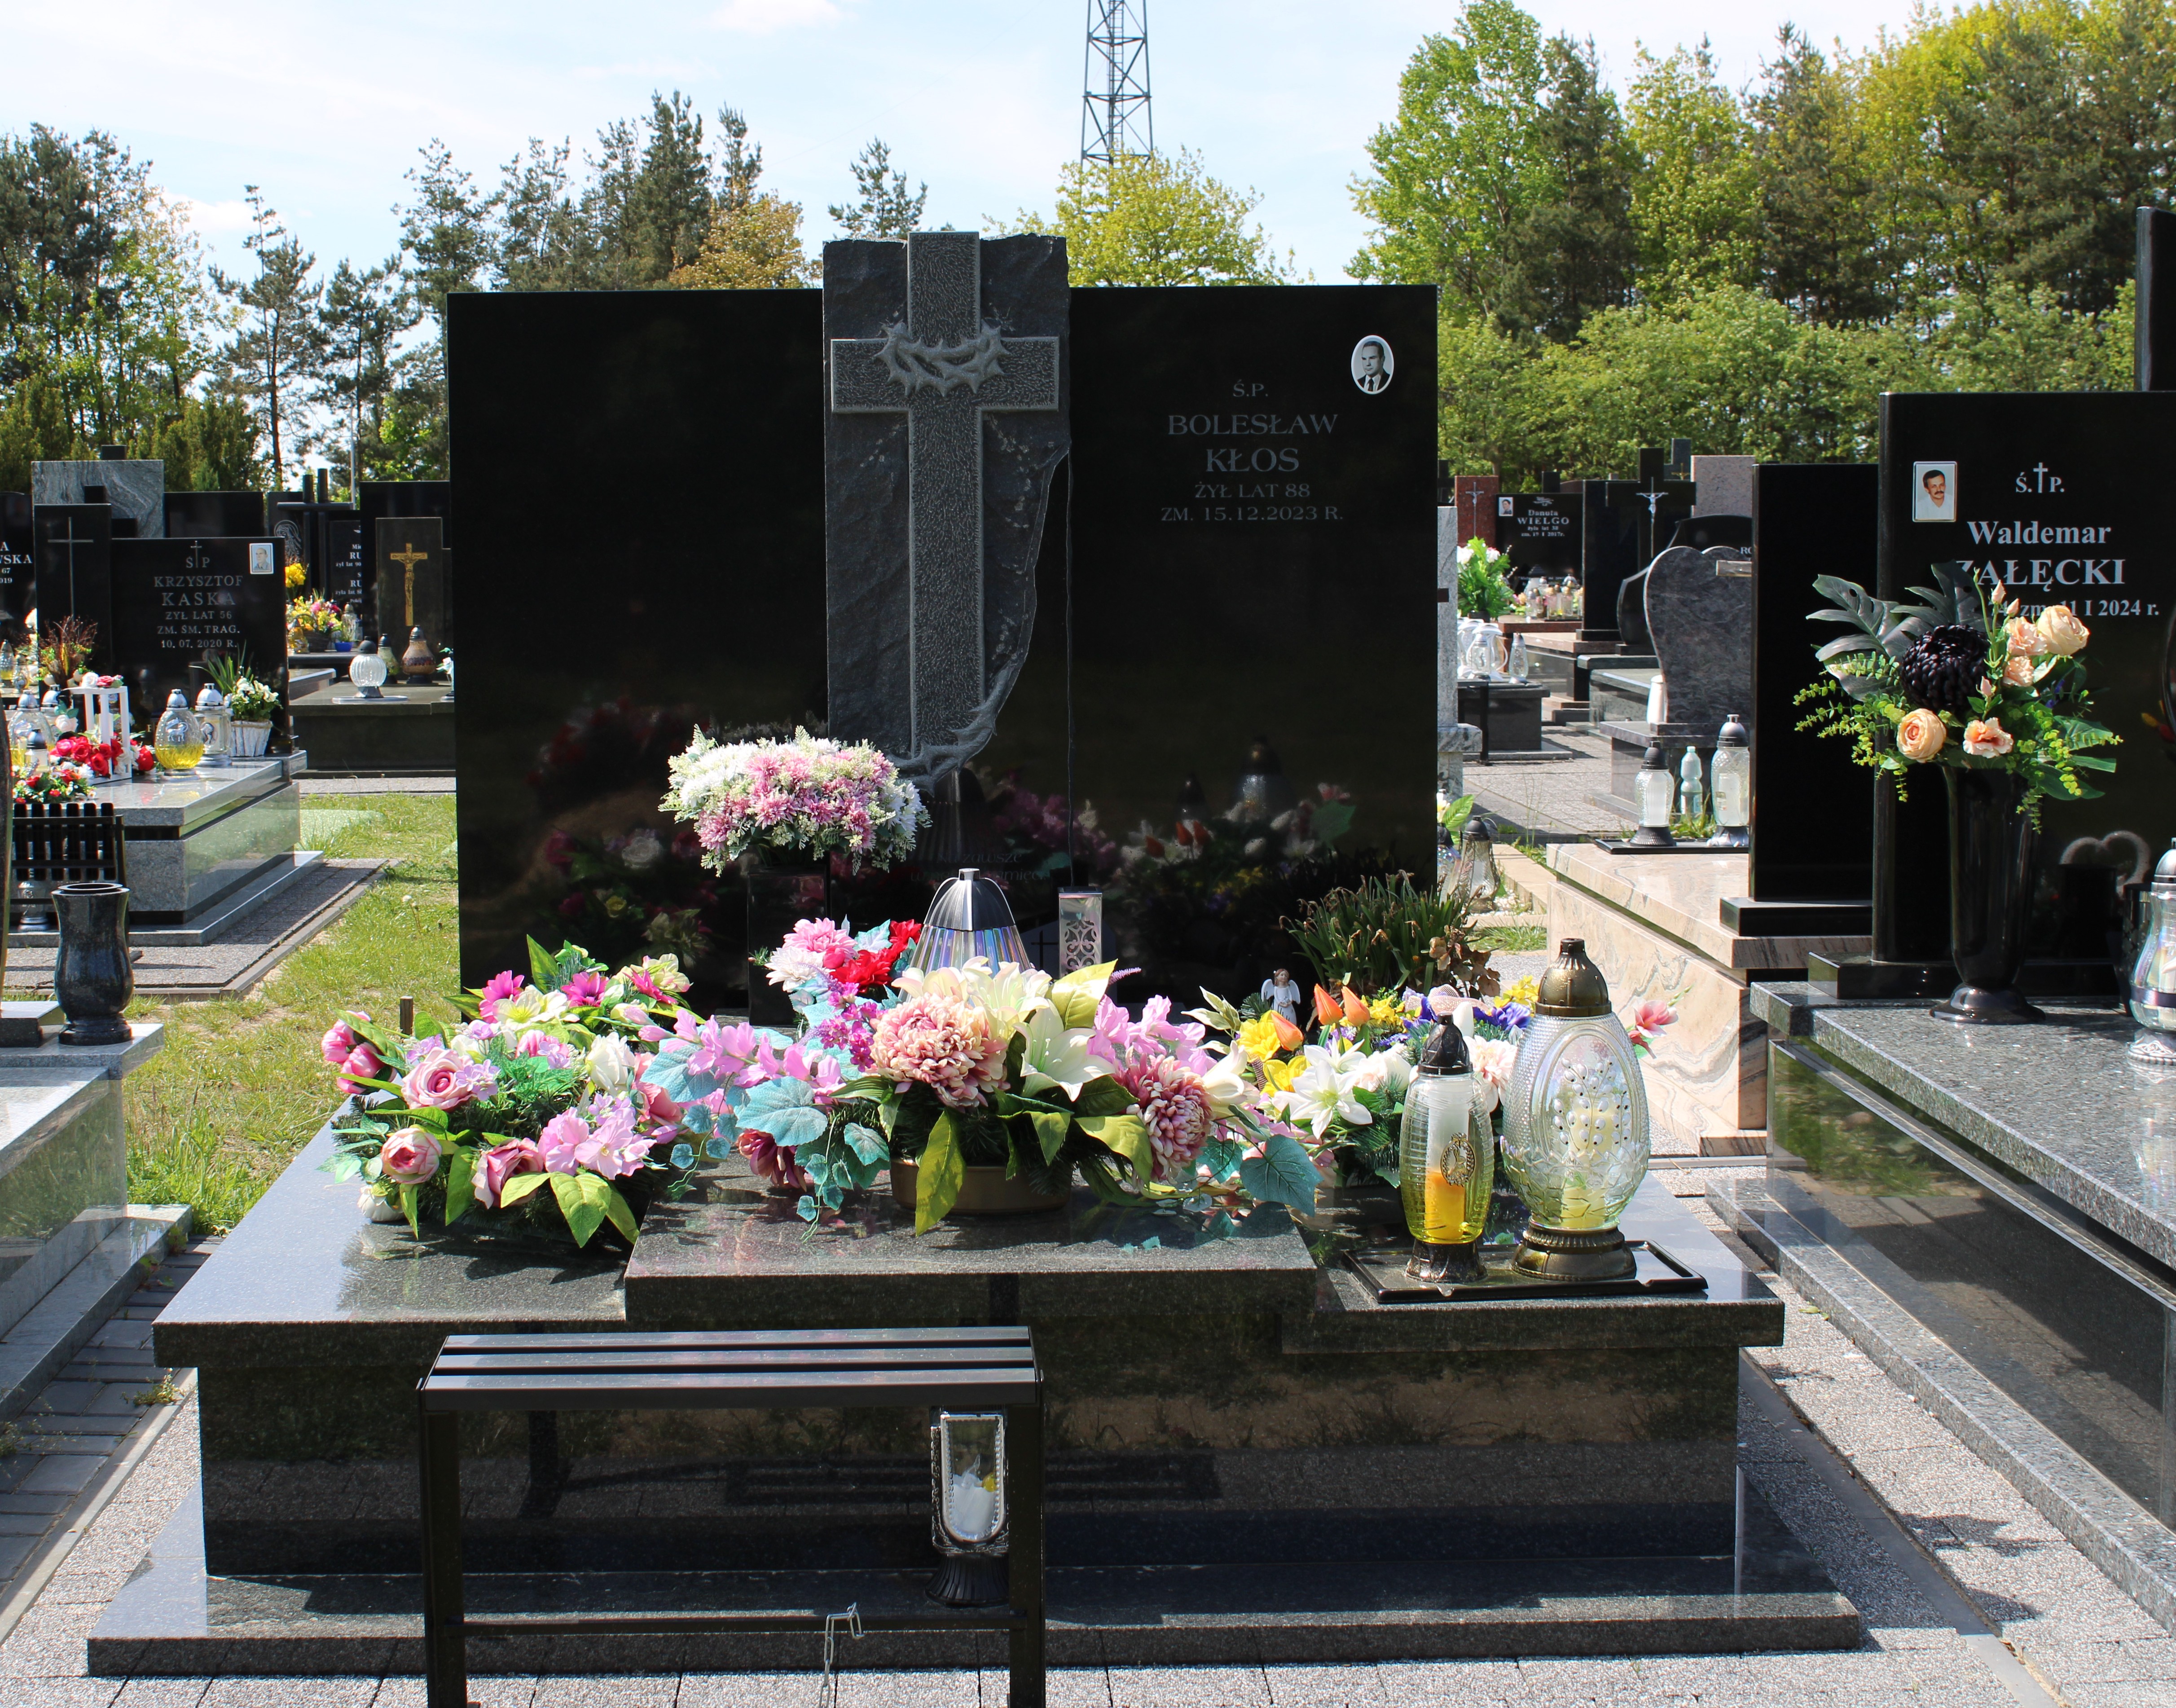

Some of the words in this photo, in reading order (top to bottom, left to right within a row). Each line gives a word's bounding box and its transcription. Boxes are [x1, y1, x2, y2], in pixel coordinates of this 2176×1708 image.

[1232, 379, 1269, 397] Ś.P.
[1168, 414, 1338, 435] BOLESŁAW
[1205, 448, 1300, 472] KŁOS
[1195, 481, 1232, 498] ŻYŁ
[1239, 484, 1279, 497] LAT
[1285, 484, 1310, 497] 88
[2049, 477, 2065, 493] P.
[1161, 507, 1194, 521] ZM.
[1204, 506, 1317, 521] 15.12.2023
[1325, 506, 1343, 520] R.
[1967, 521, 2112, 545] Waldemar
[154, 576, 243, 587] KRZYSZTOF
[162, 592, 236, 606] KASKA
[193, 611, 214, 619] LAT
[2084, 600, 2092, 616] I
[2097, 599, 2141, 616] 2024
[2147, 604, 2159, 616] r.
[157, 626, 177, 634] ZM.
[204, 625, 240, 633] TRAG.
[162, 640, 175, 648] 10.
[179, 639, 193, 648] 07.
[197, 639, 222, 647] 2020
[227, 639, 237, 647] R.
[963, 853, 1022, 863] zawsze
